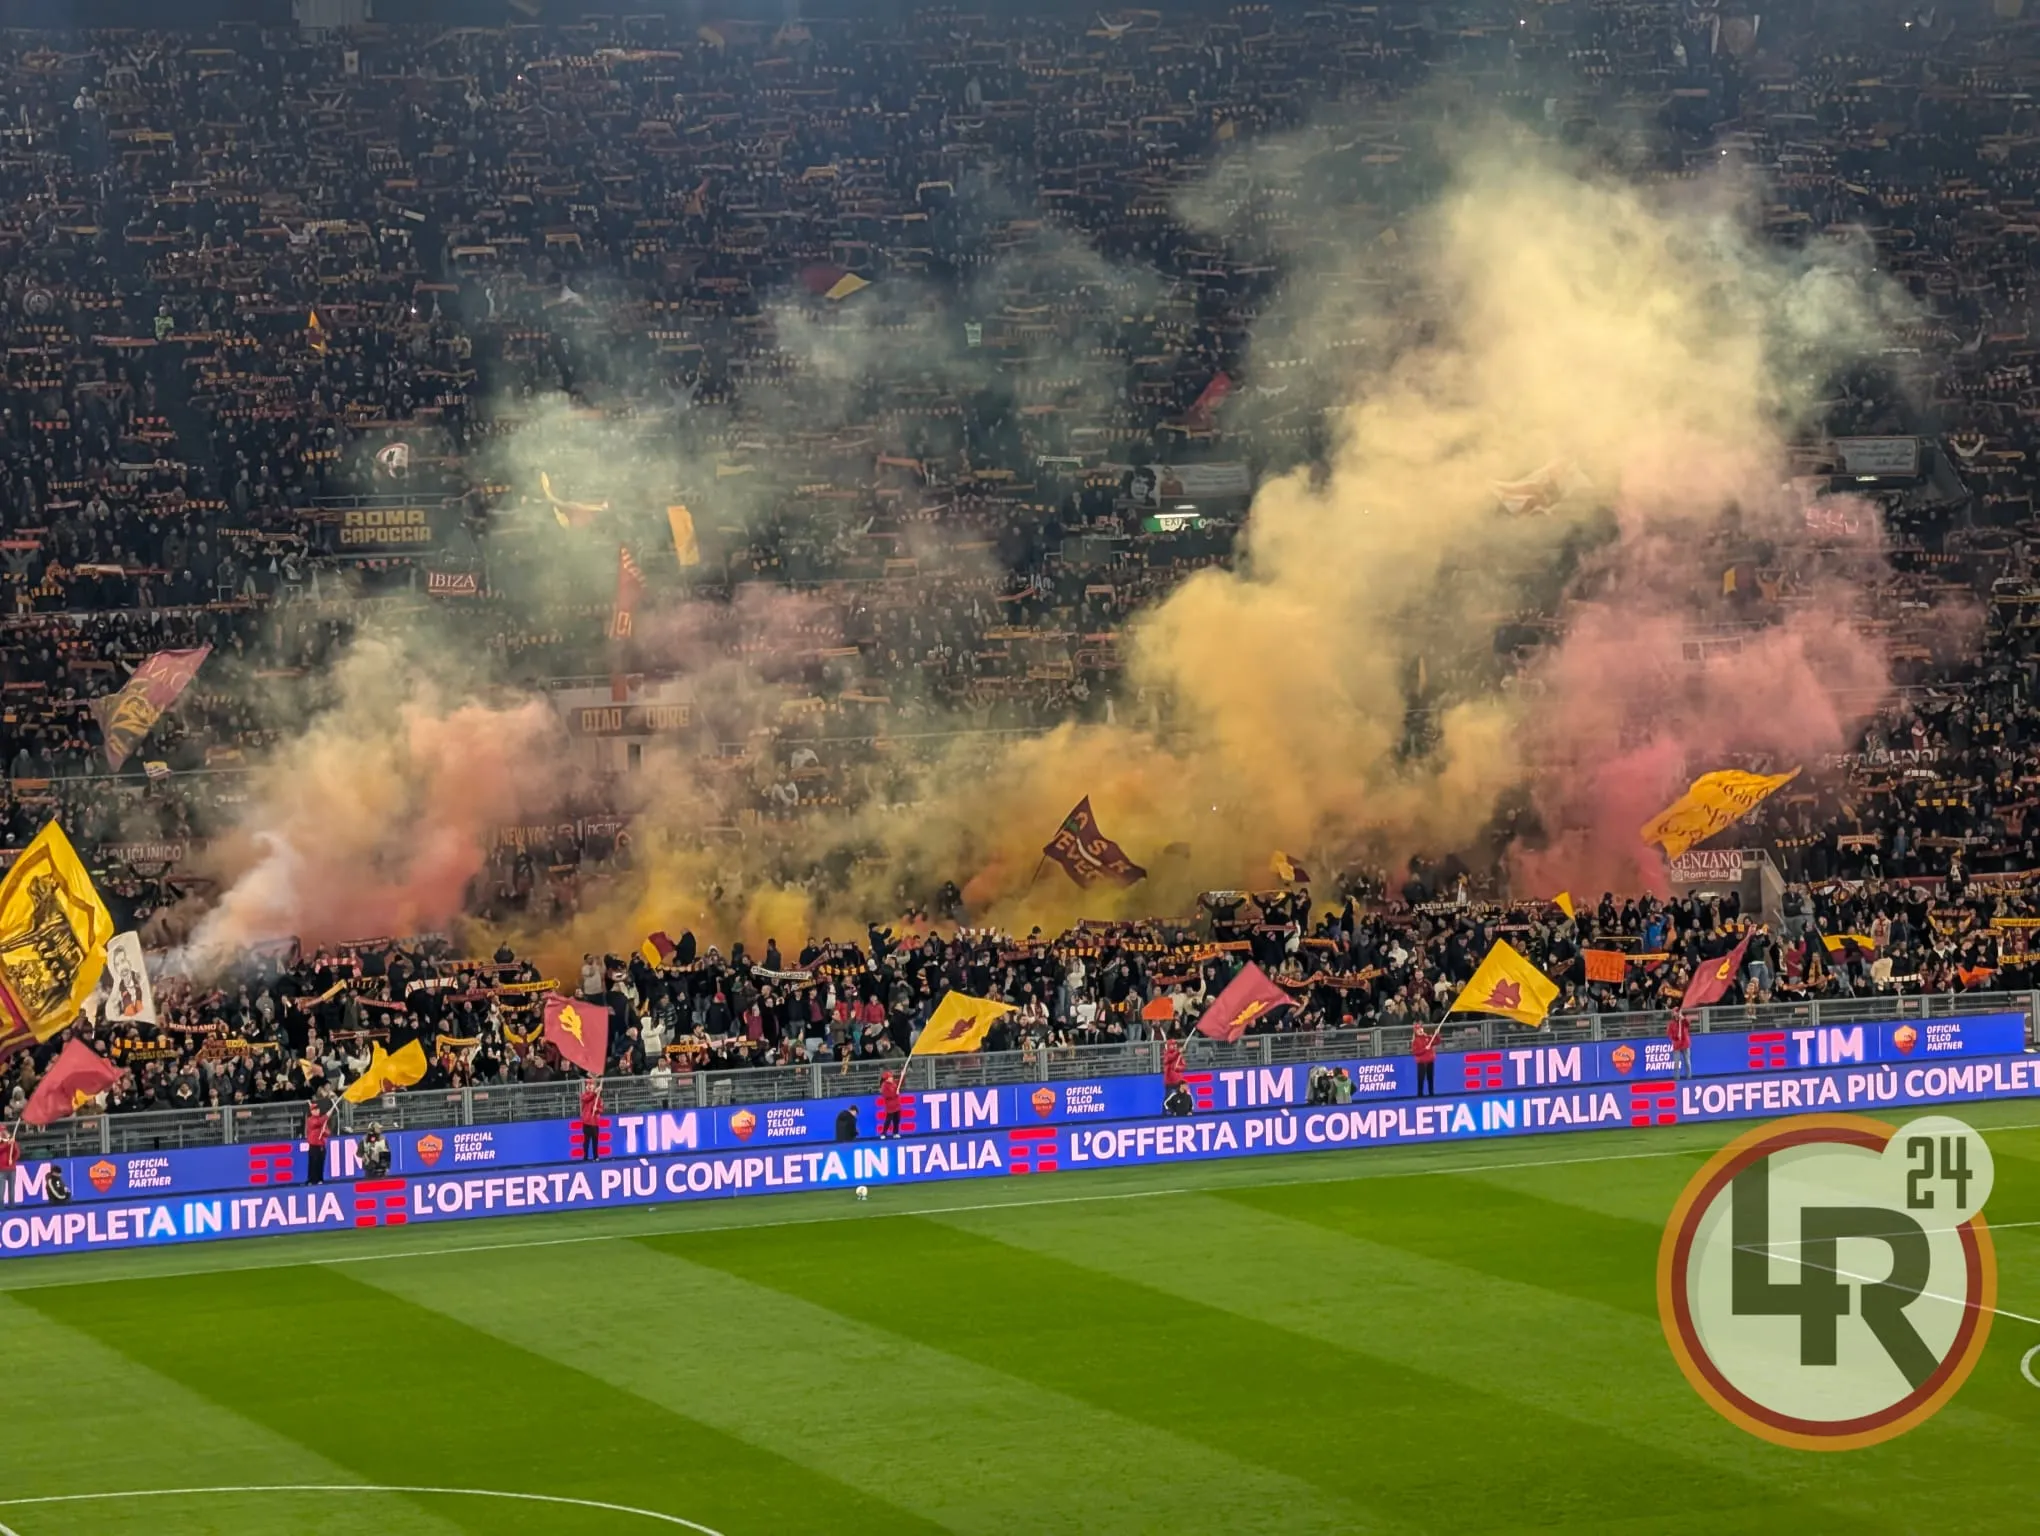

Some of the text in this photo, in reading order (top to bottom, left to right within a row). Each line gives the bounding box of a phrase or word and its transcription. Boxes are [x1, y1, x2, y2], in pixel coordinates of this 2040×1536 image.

[344, 510, 426, 527] ROMA
[340, 526, 431, 544] CAPOCCIA
[429, 572, 475, 588] IBIZA
[1670, 851, 1742, 870] GENZANO
[1708, 869, 1729, 878] Club
[1927, 1023, 1961, 1035] OFFICIAL
[1927, 1033, 1951, 1042] TELCO
[1792, 1027, 1863, 1065] TIM
[1927, 1041, 1963, 1052] PARTNER
[1645, 1052, 1670, 1063] TELCO
[1359, 1063, 1395, 1075] OFFICIAL
[1509, 1047, 1582, 1086] TIM
[1359, 1073, 1384, 1083] TELCO
[1847, 1064, 1898, 1102] PIÙ
[1066, 1085, 1103, 1097] OFFICIAL
[1219, 1067, 1294, 1107] TIM
[1359, 1081, 1397, 1093] PARTNER
[1066, 1095, 1093, 1105] TELCO
[766, 1107, 805, 1120] OFFICIAL
[922, 1089, 999, 1130] TIM
[1066, 1103, 1105, 1115] PARTNER
[767, 1117, 794, 1128] TELCO
[1245, 1108, 1298, 1148] PIÙ
[1304, 1102, 1476, 1143] COMPLETA
[1482, 1099, 1515, 1130] IN
[1523, 1092, 1622, 1127] ITALIA
[454, 1131, 493, 1144] OFFICIAL
[618, 1111, 698, 1154] TIM
[767, 1126, 807, 1138] PARTNER
[454, 1142, 482, 1153] TELCO
[454, 1150, 496, 1163] PARTNER
[127, 1157, 169, 1170] OFFICIAL
[601, 1158, 657, 1200] PIÙ
[665, 1151, 847, 1195] COMPLETA
[854, 1146, 889, 1179] IN
[897, 1139, 1002, 1175] ITALIA
[128, 1168, 157, 1179] TELCO
[128, 1176, 172, 1189] PARTNER
[0, 1192, 345, 1249] OMPLETA IN ITALIA
